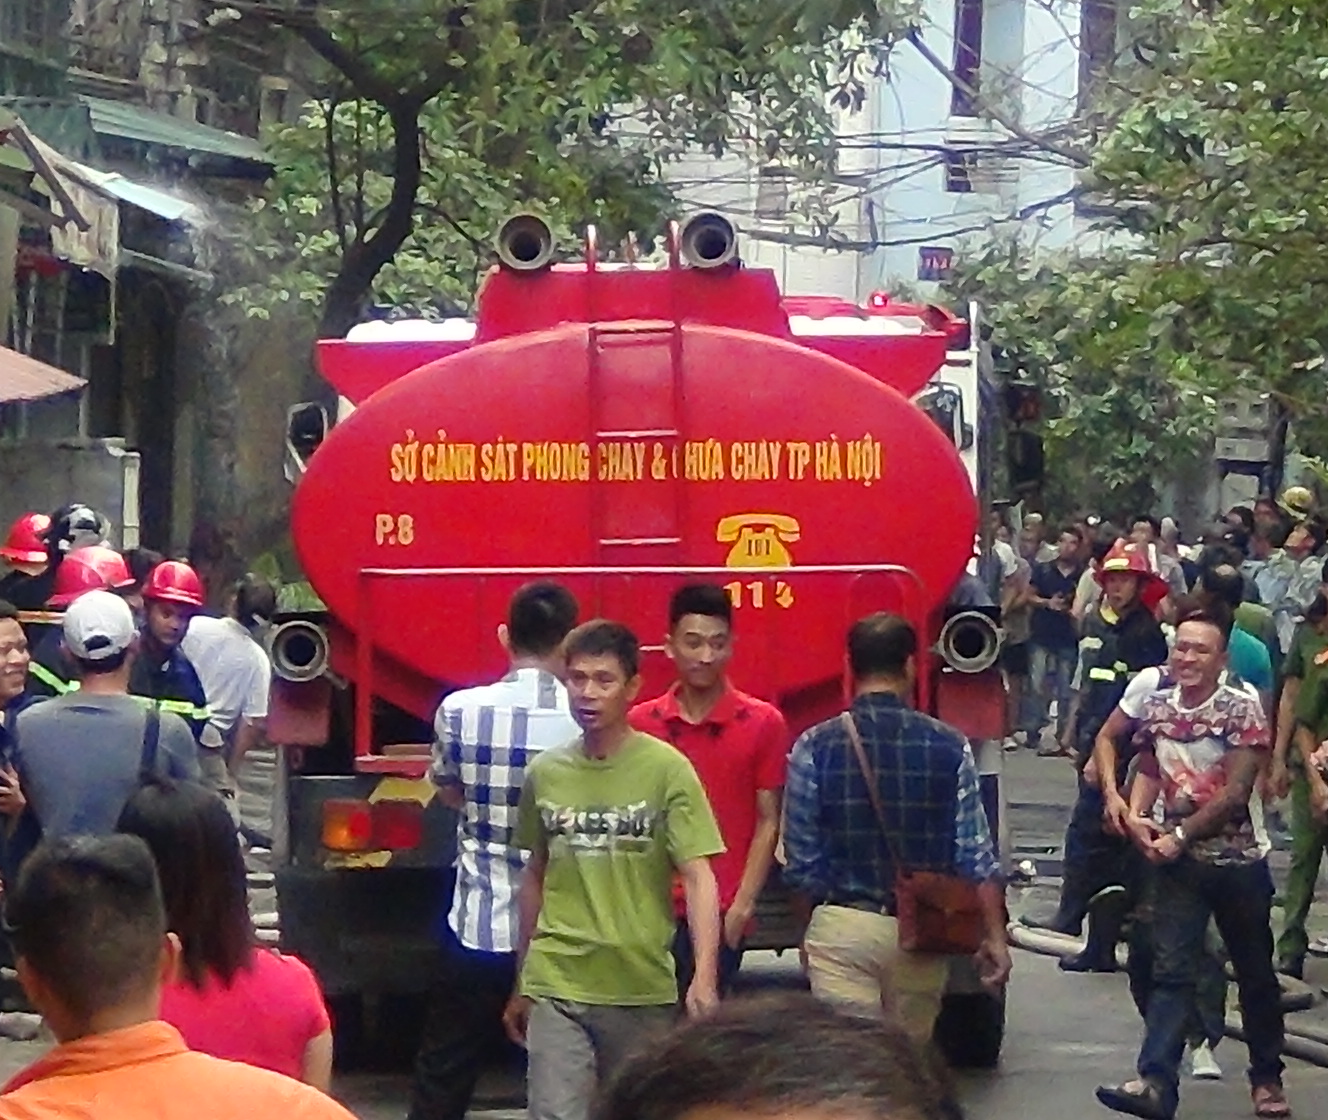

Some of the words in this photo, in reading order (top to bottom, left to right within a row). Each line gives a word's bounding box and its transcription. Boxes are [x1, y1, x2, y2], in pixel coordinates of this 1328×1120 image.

[480, 435, 518, 482] SÁT
[650, 442, 667, 481] &
[787, 442, 811, 481] TP
[815, 432, 842, 481] HÀ
[375, 513, 414, 546] P.8
